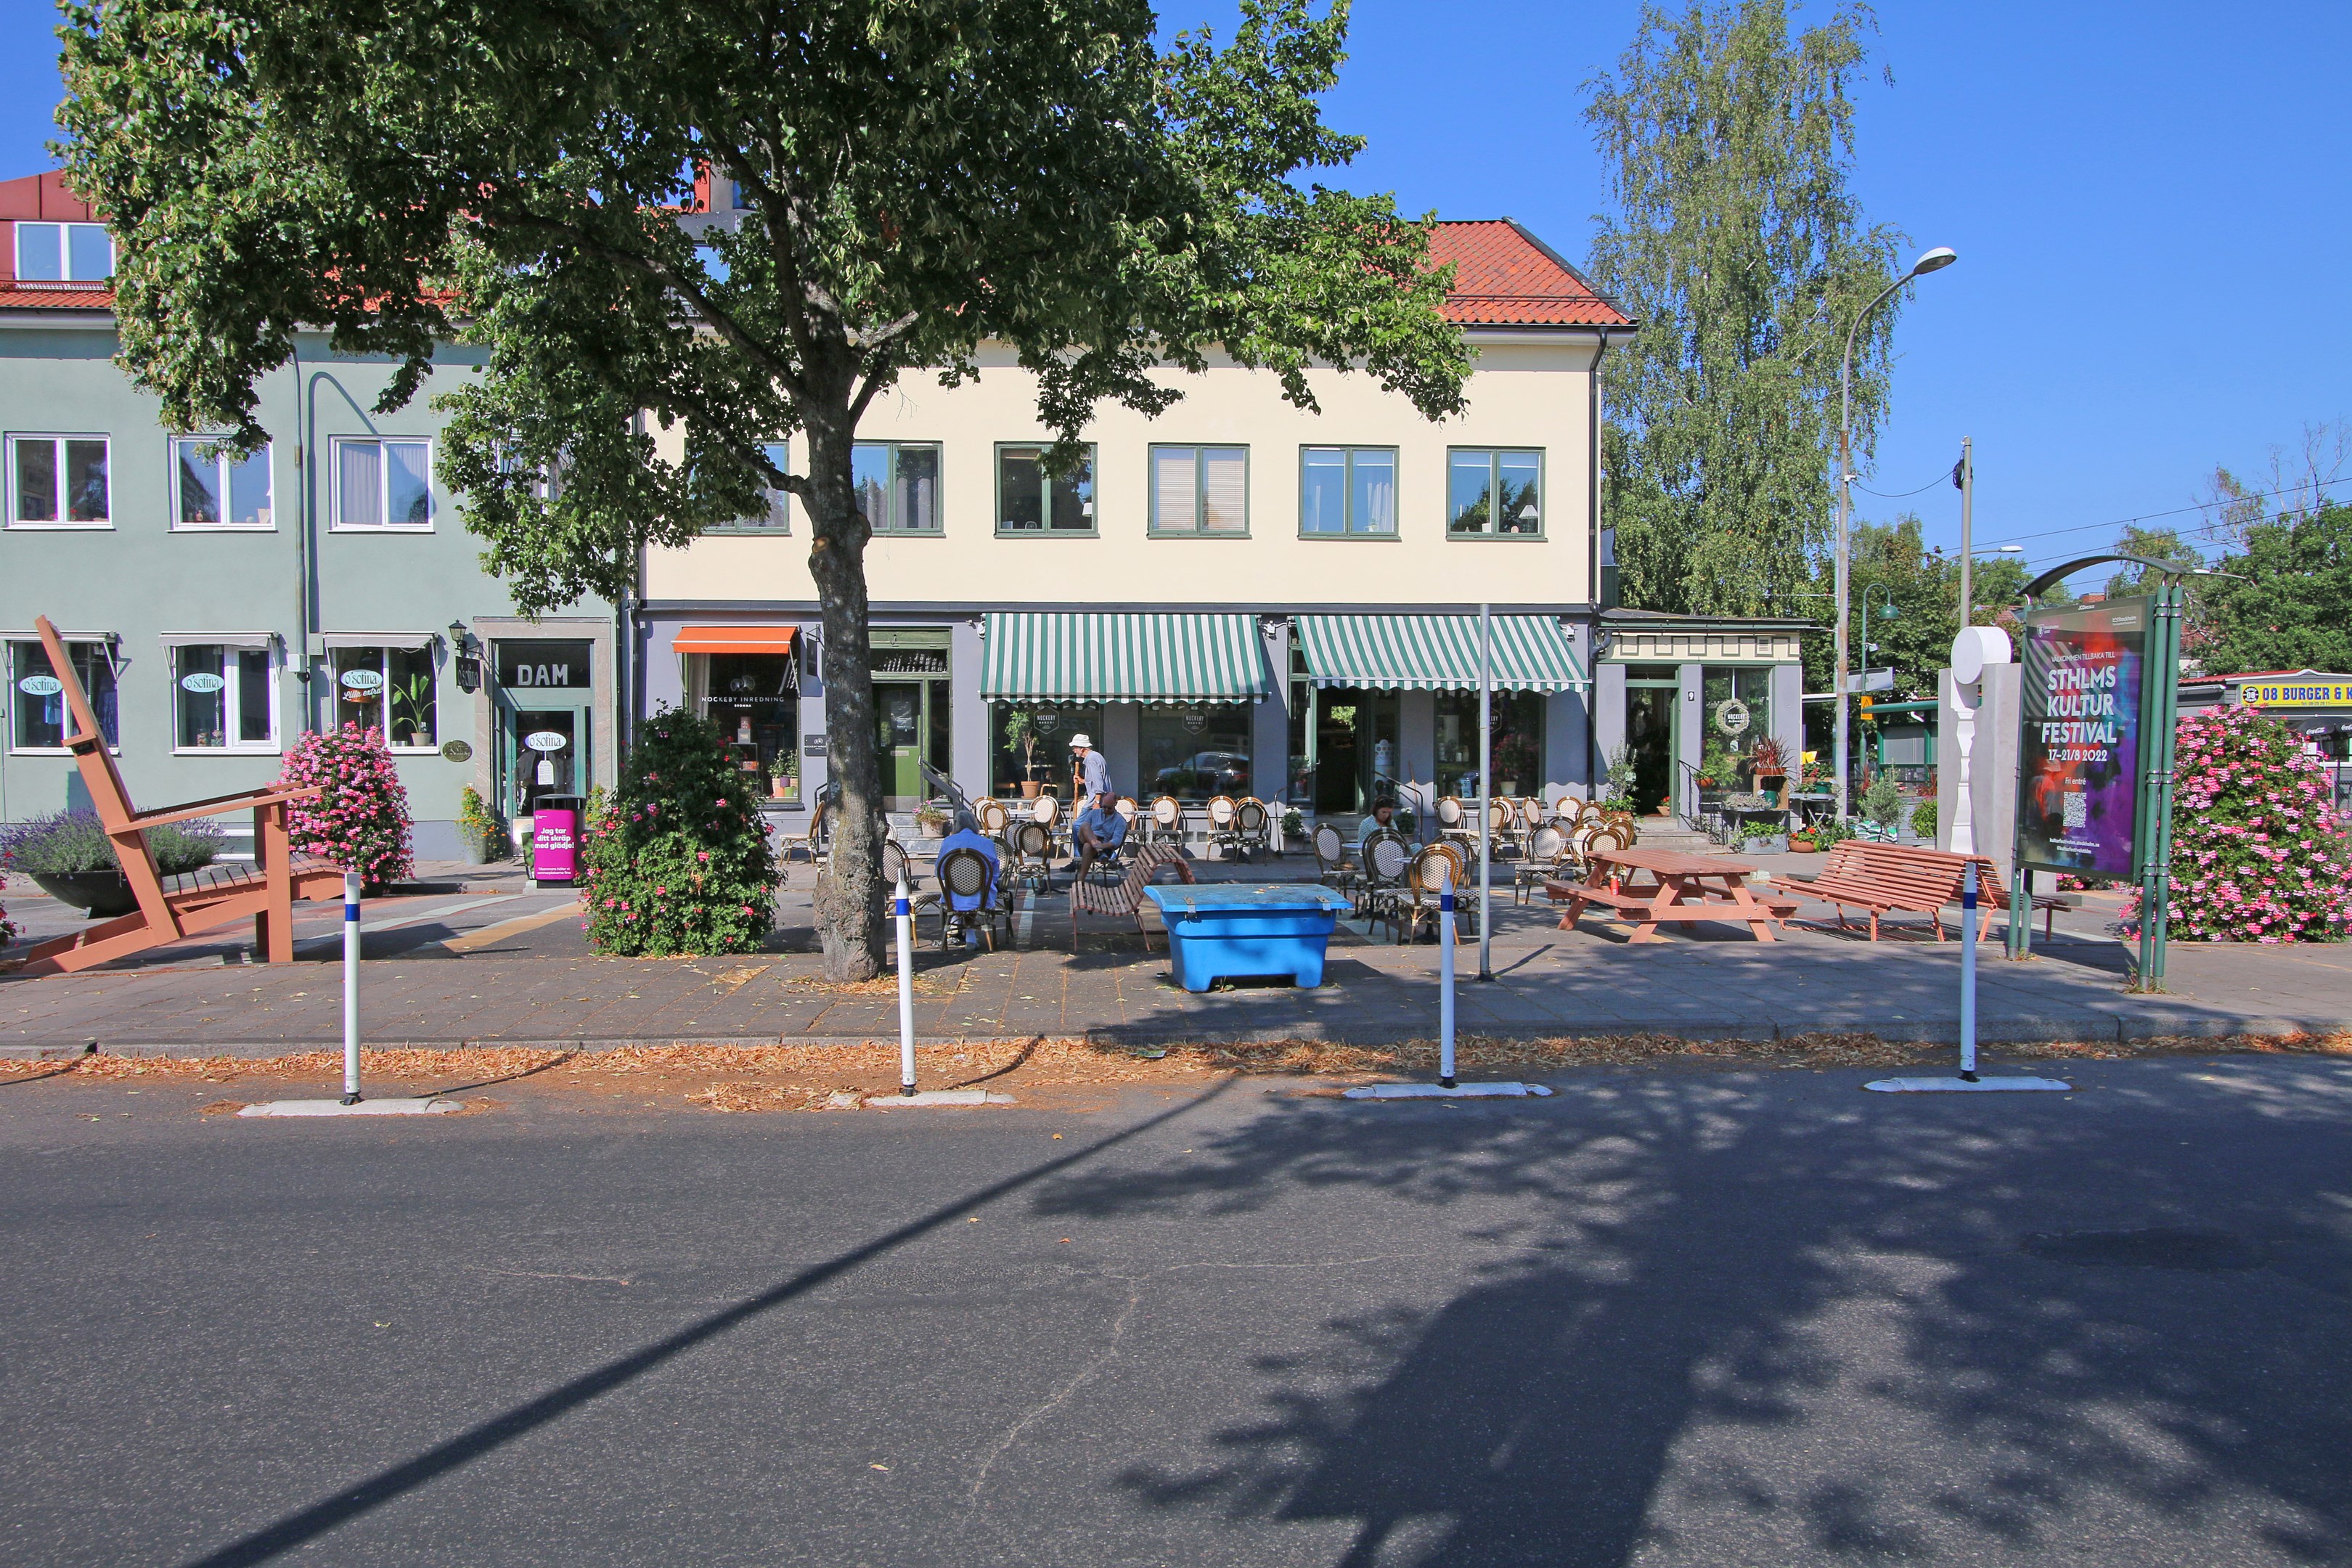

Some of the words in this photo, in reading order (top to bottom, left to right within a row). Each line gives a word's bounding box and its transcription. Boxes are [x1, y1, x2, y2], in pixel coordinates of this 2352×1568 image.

[2051, 653, 2081, 662] VÄLKOMMEN
[518, 664, 568, 685] DAM
[2047, 666, 2116, 690] STHLMS
[363, 687, 382, 696] extra
[2263, 687, 2278, 701] 08
[2282, 687, 2329, 701] BURGER
[2334, 687, 2341, 700] &
[2047, 693, 2114, 716] KULTUR
[2041, 722, 2117, 743] FESTIVAL
[2082, 749, 2107, 761] 2022
